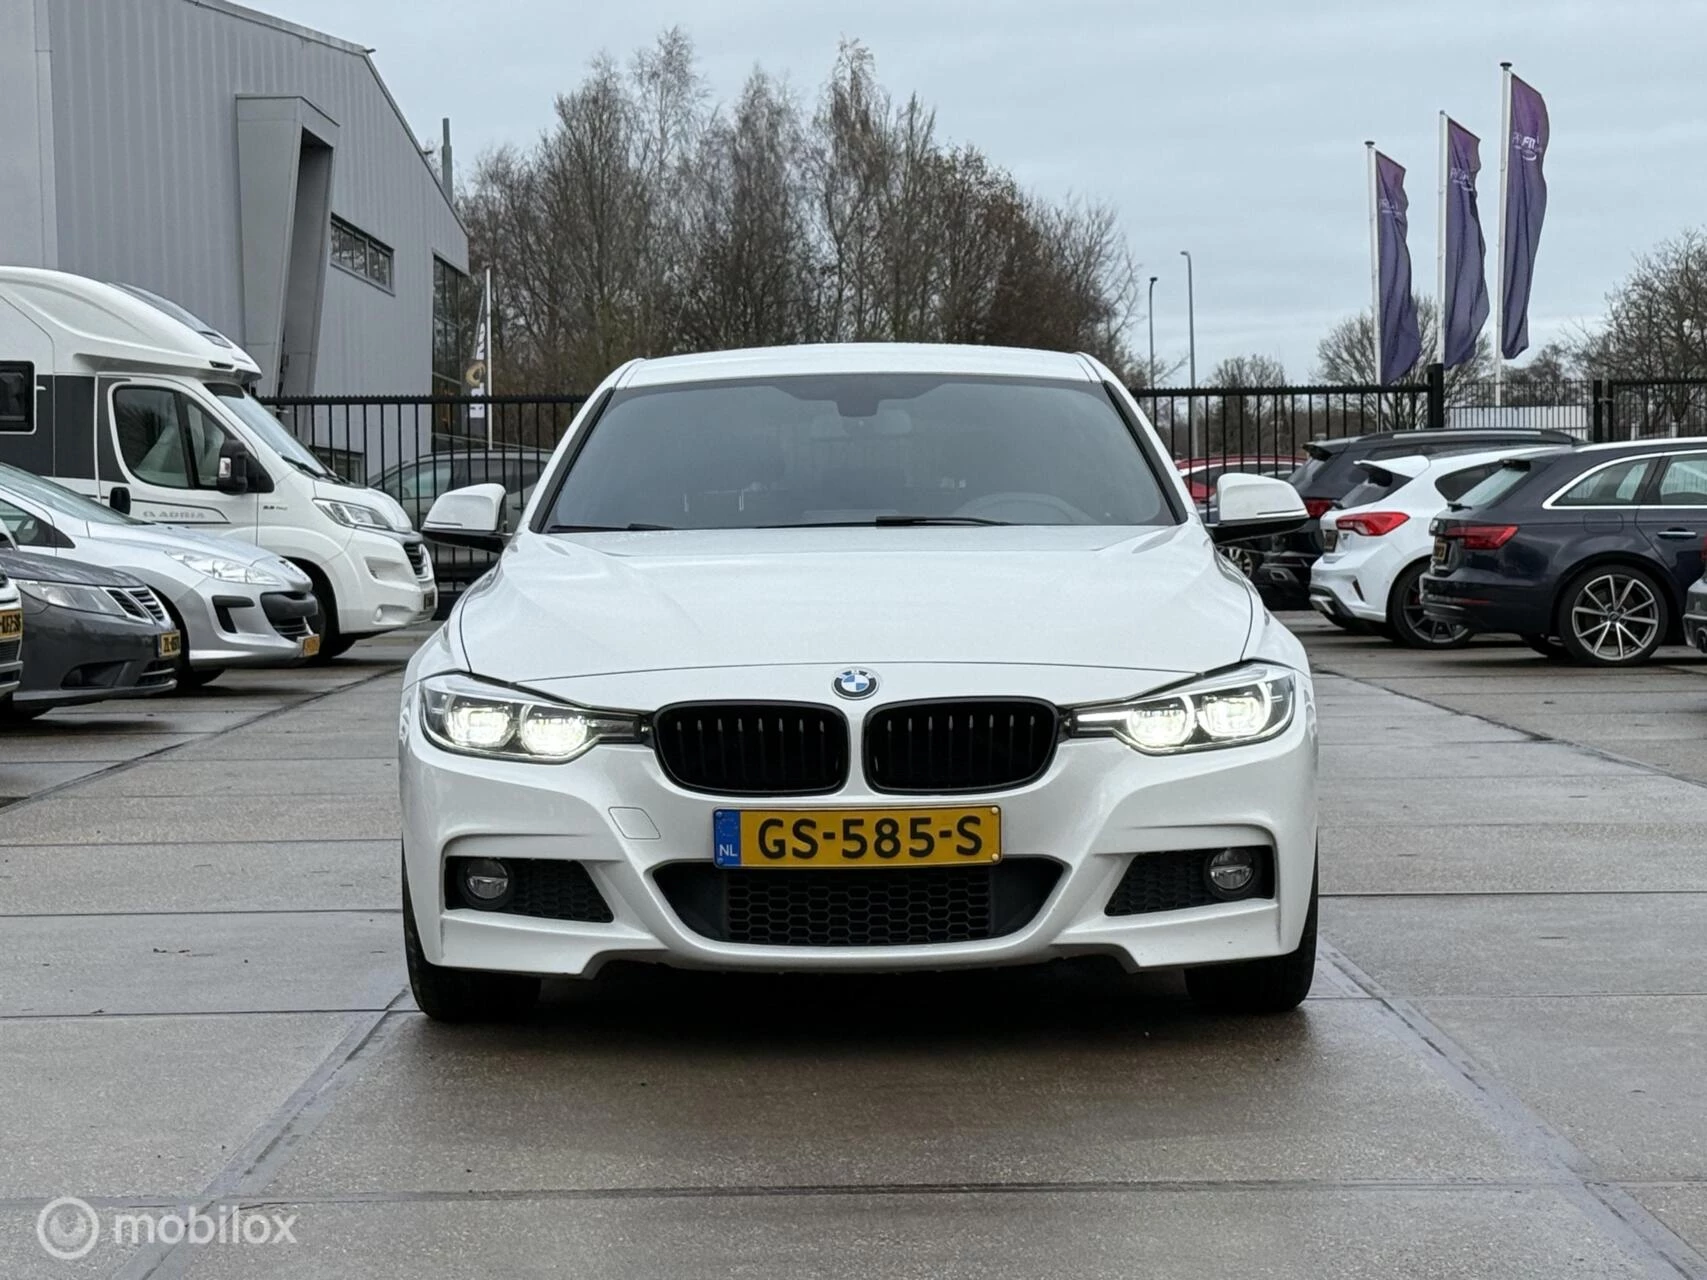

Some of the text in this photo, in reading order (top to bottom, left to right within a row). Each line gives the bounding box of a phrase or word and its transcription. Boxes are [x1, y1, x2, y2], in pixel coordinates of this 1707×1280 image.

[158, 510, 205, 519] ADRIA
[757, 814, 983, 860] GS-585-S
[719, 843, 738, 857] NL
